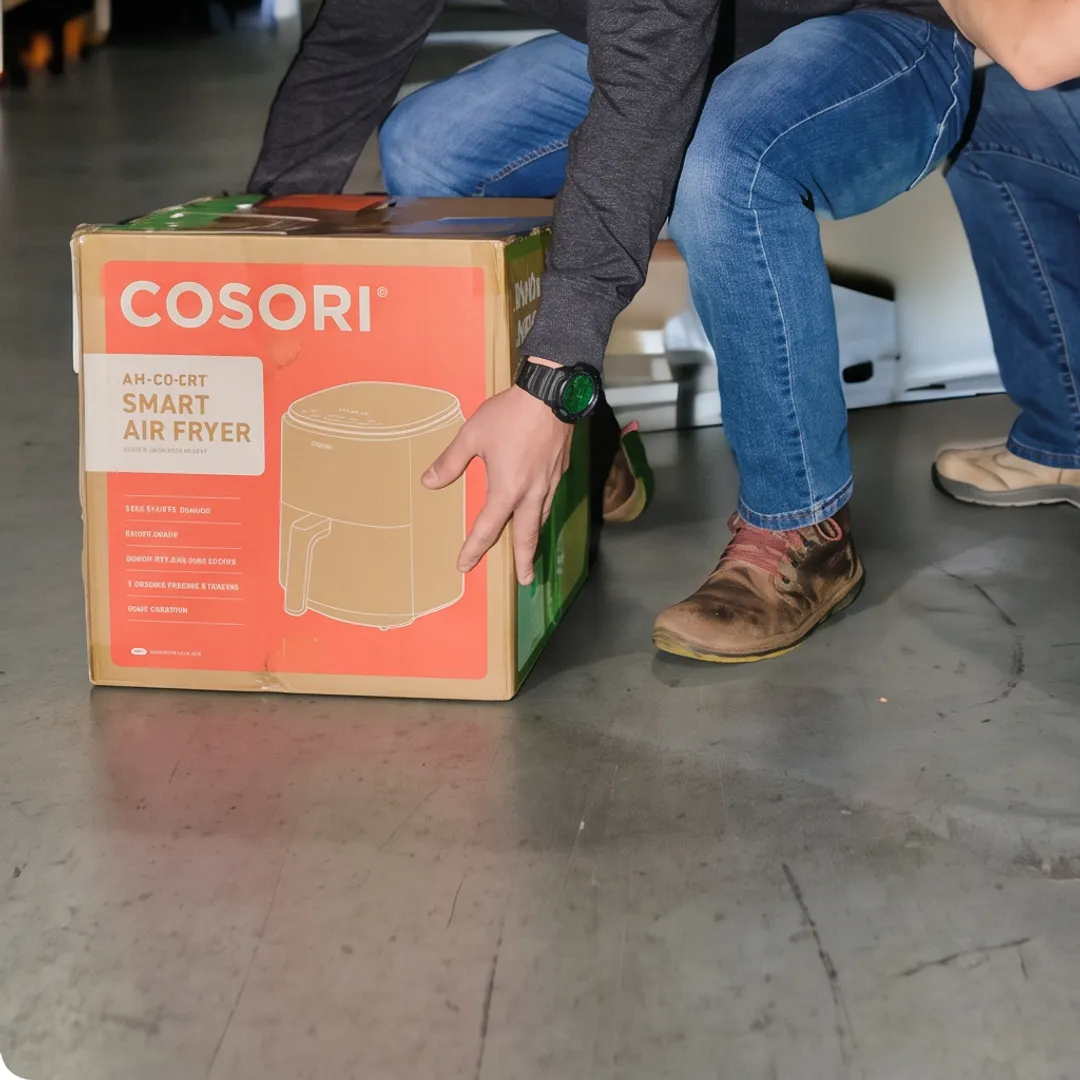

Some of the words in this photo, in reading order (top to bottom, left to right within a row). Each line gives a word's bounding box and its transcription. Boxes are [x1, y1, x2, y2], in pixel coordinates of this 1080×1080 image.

[120, 280, 371, 332] COSORI
[122, 392, 210, 415] SMART
[122, 419, 165, 441] AIR
[173, 420, 251, 443] FRYER
